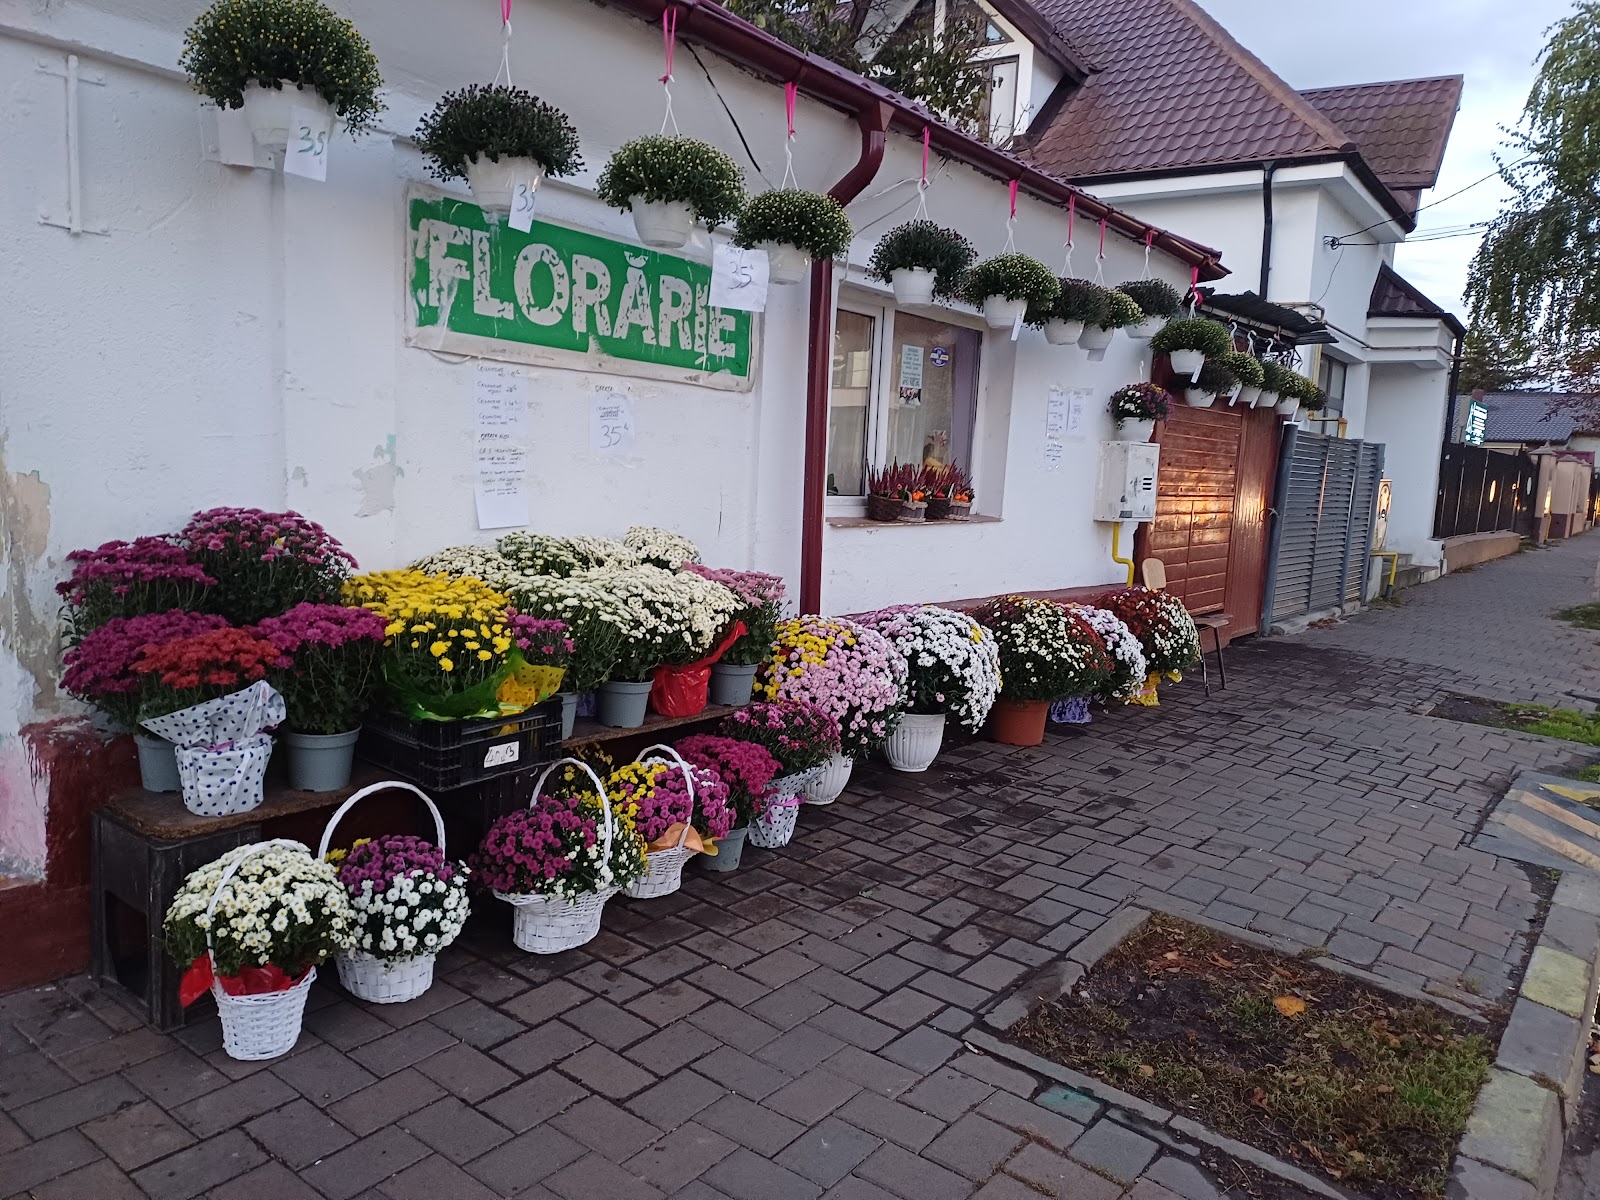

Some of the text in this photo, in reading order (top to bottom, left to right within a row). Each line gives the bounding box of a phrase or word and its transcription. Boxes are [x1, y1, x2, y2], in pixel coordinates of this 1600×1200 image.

[298, 126, 326, 157] 35
[417, 217, 737, 358] FLORĂRIE
[728, 261, 752, 290] 35
[599, 424, 622, 449] 35
